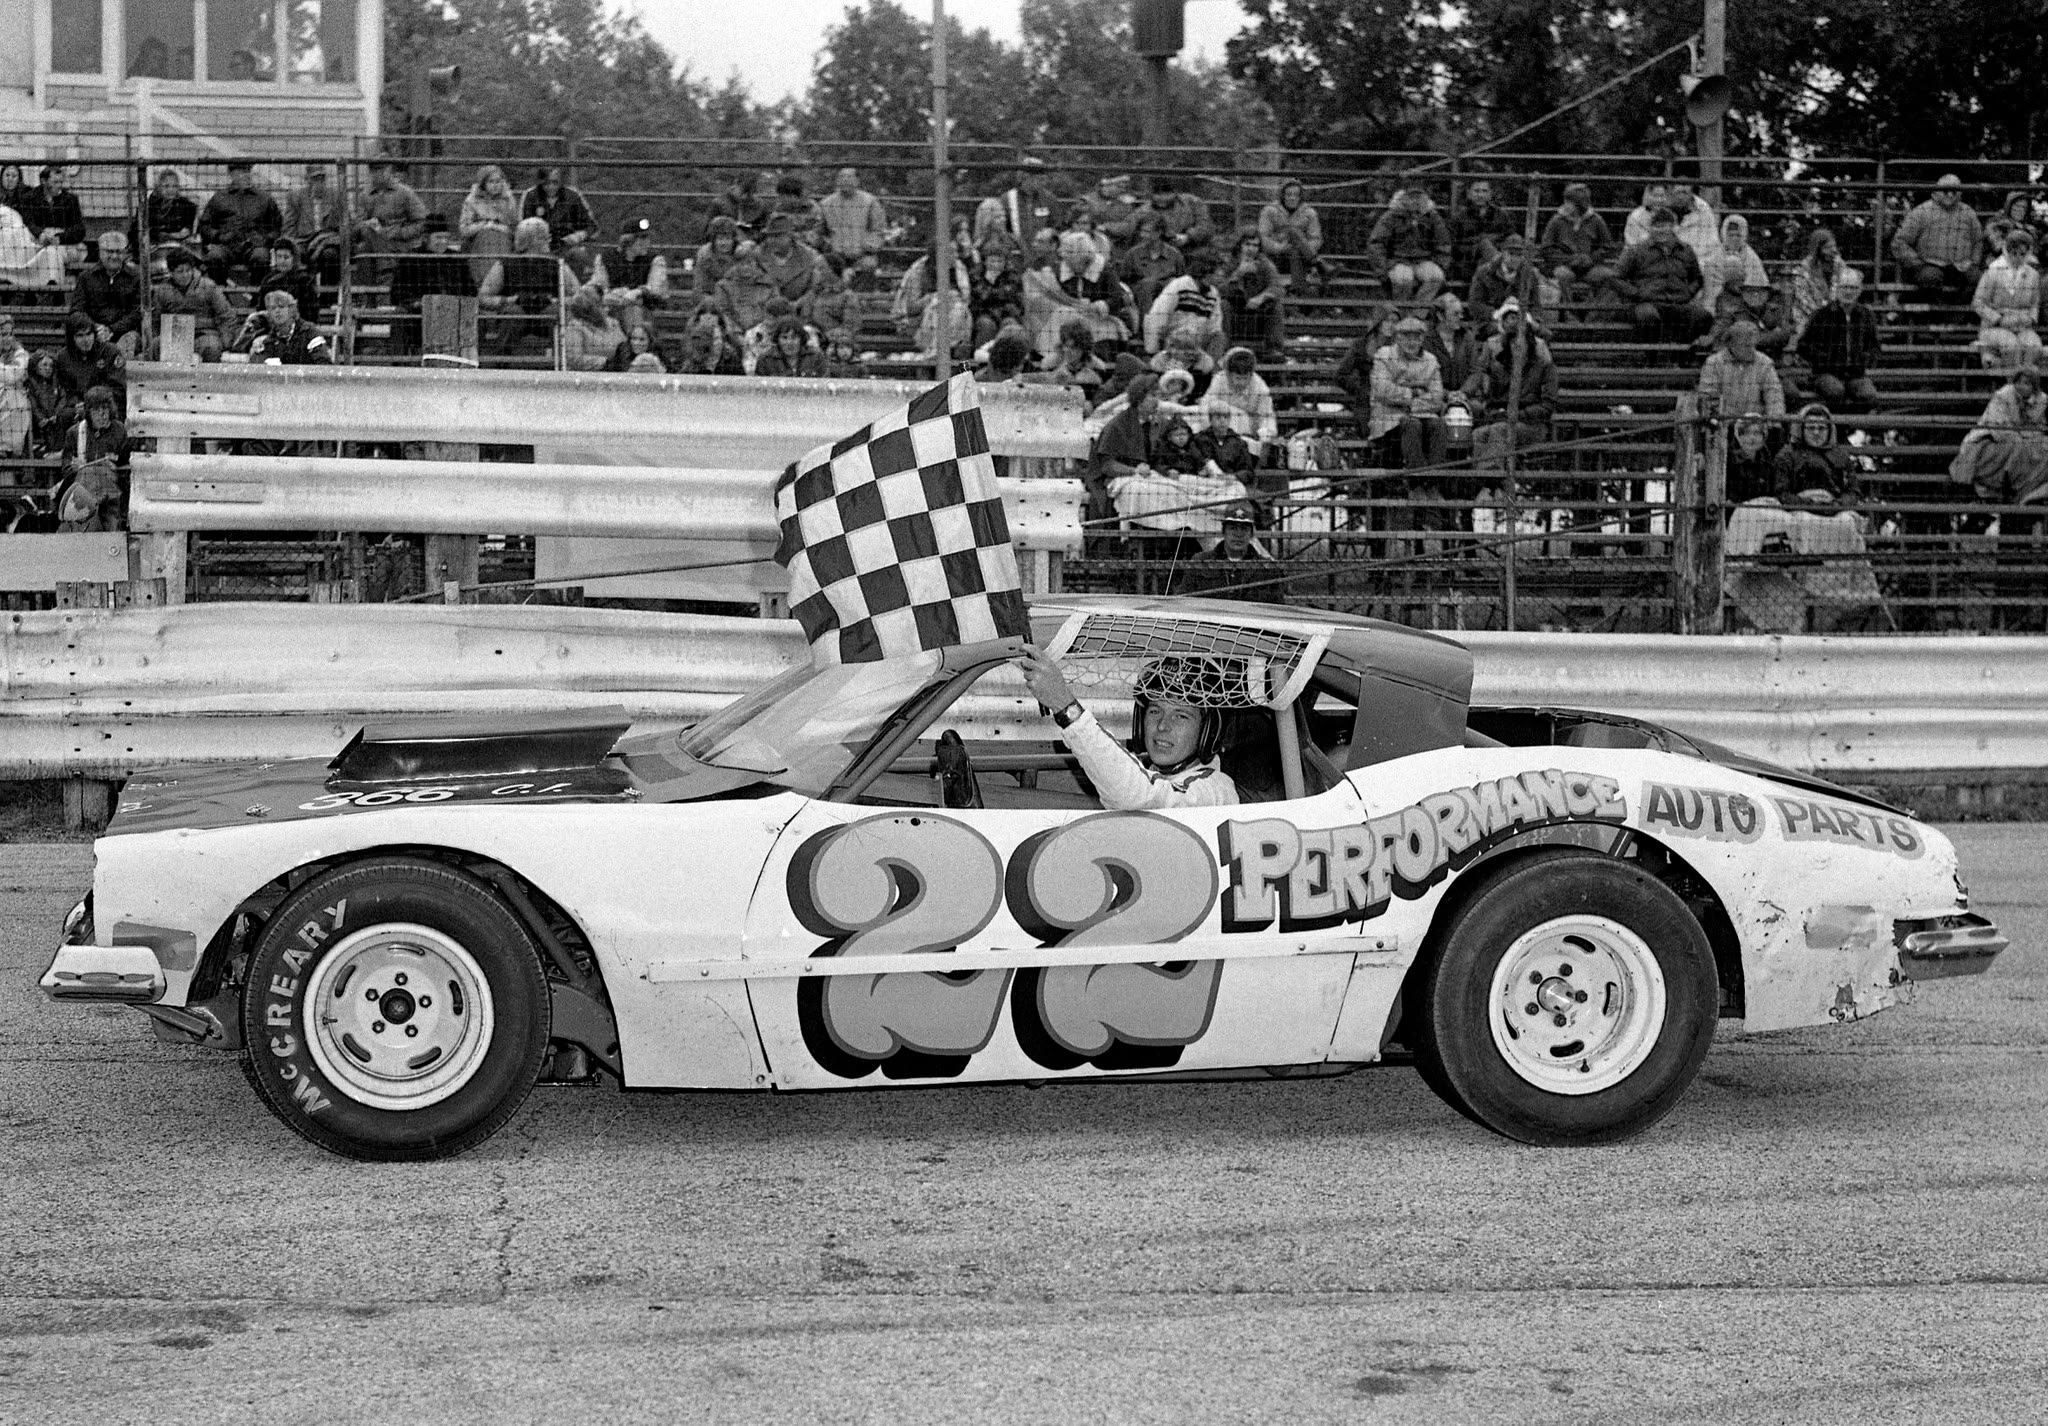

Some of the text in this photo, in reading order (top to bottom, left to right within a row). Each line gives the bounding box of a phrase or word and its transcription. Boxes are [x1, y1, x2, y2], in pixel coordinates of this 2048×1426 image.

[299, 786, 460, 810] 366
[1217, 768, 1919, 934] PERFORMANCE AUTO PARTS
[786, 811, 1224, 1080] 22
